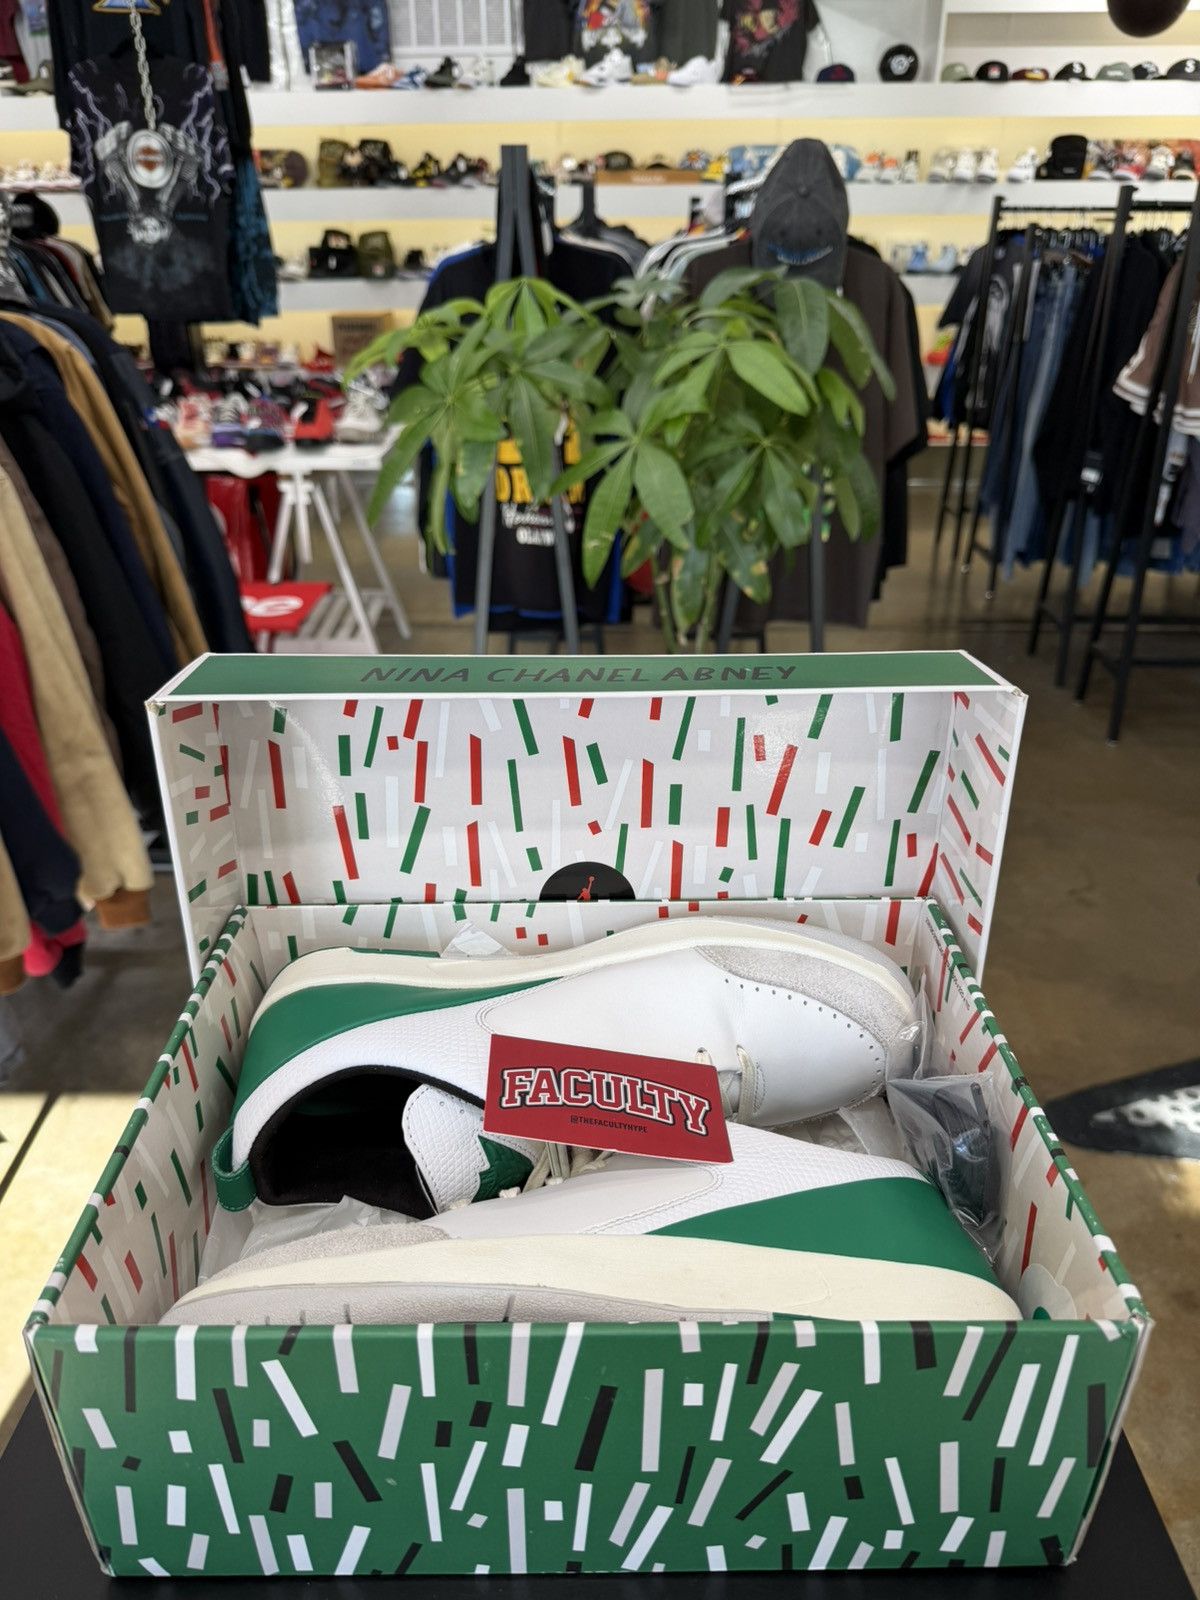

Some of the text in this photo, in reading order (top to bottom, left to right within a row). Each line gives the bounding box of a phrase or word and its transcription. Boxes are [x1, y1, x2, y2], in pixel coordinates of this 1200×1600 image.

[361, 665, 797, 683] NINA CHANEL ABNEY
[500, 1066, 712, 1137] FACULTY
[570, 1114, 648, 1134] @THEFACULTYHYPE
